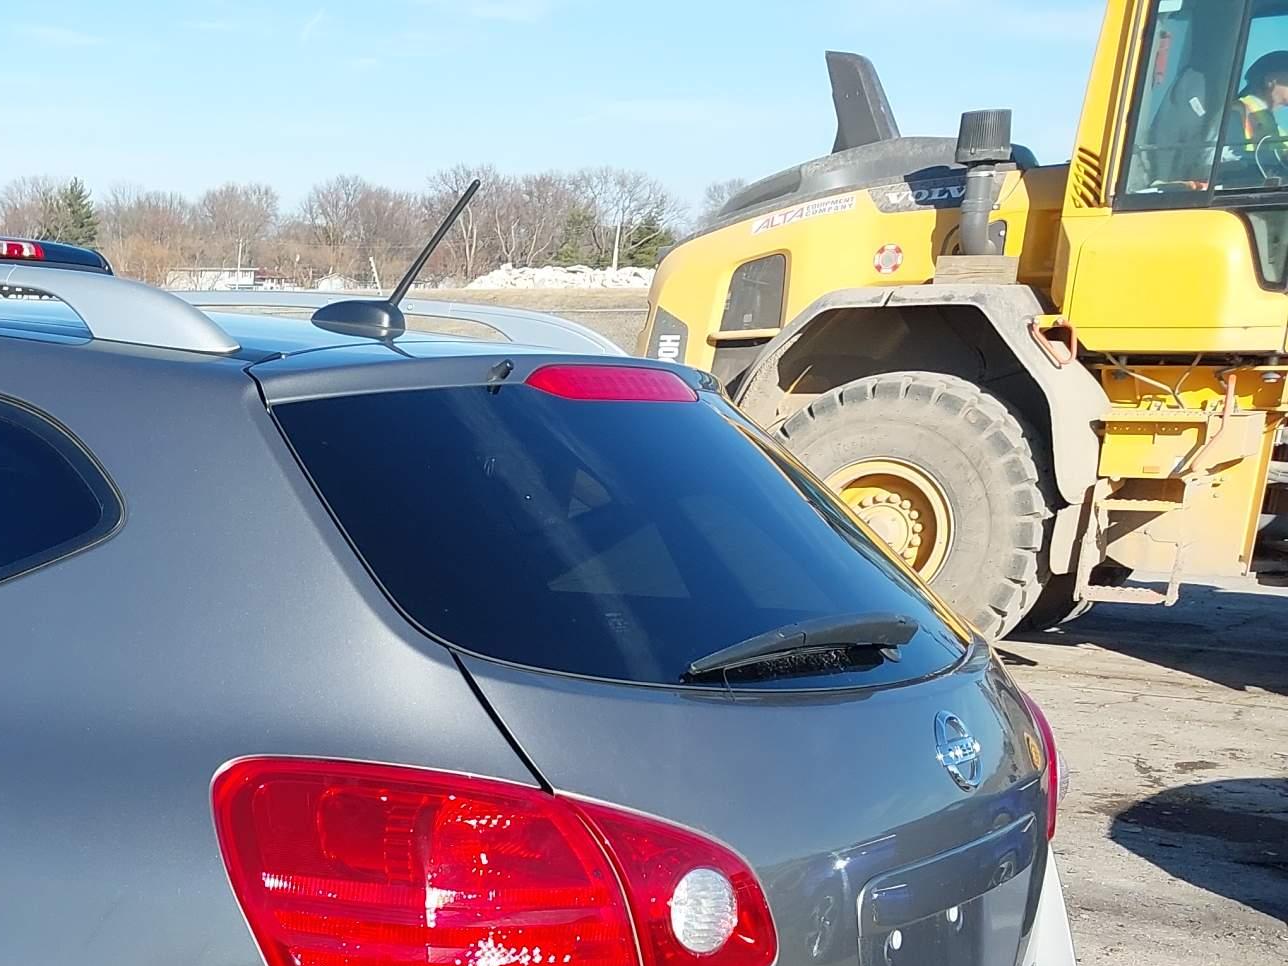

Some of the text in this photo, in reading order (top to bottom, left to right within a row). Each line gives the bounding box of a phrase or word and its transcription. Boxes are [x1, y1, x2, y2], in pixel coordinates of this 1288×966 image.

[885, 185, 966, 204] VOLV
[805, 203, 854, 217] COMPANY
[806, 196, 855, 211] EQUIPMENT
[754, 207, 805, 233] ALTA
